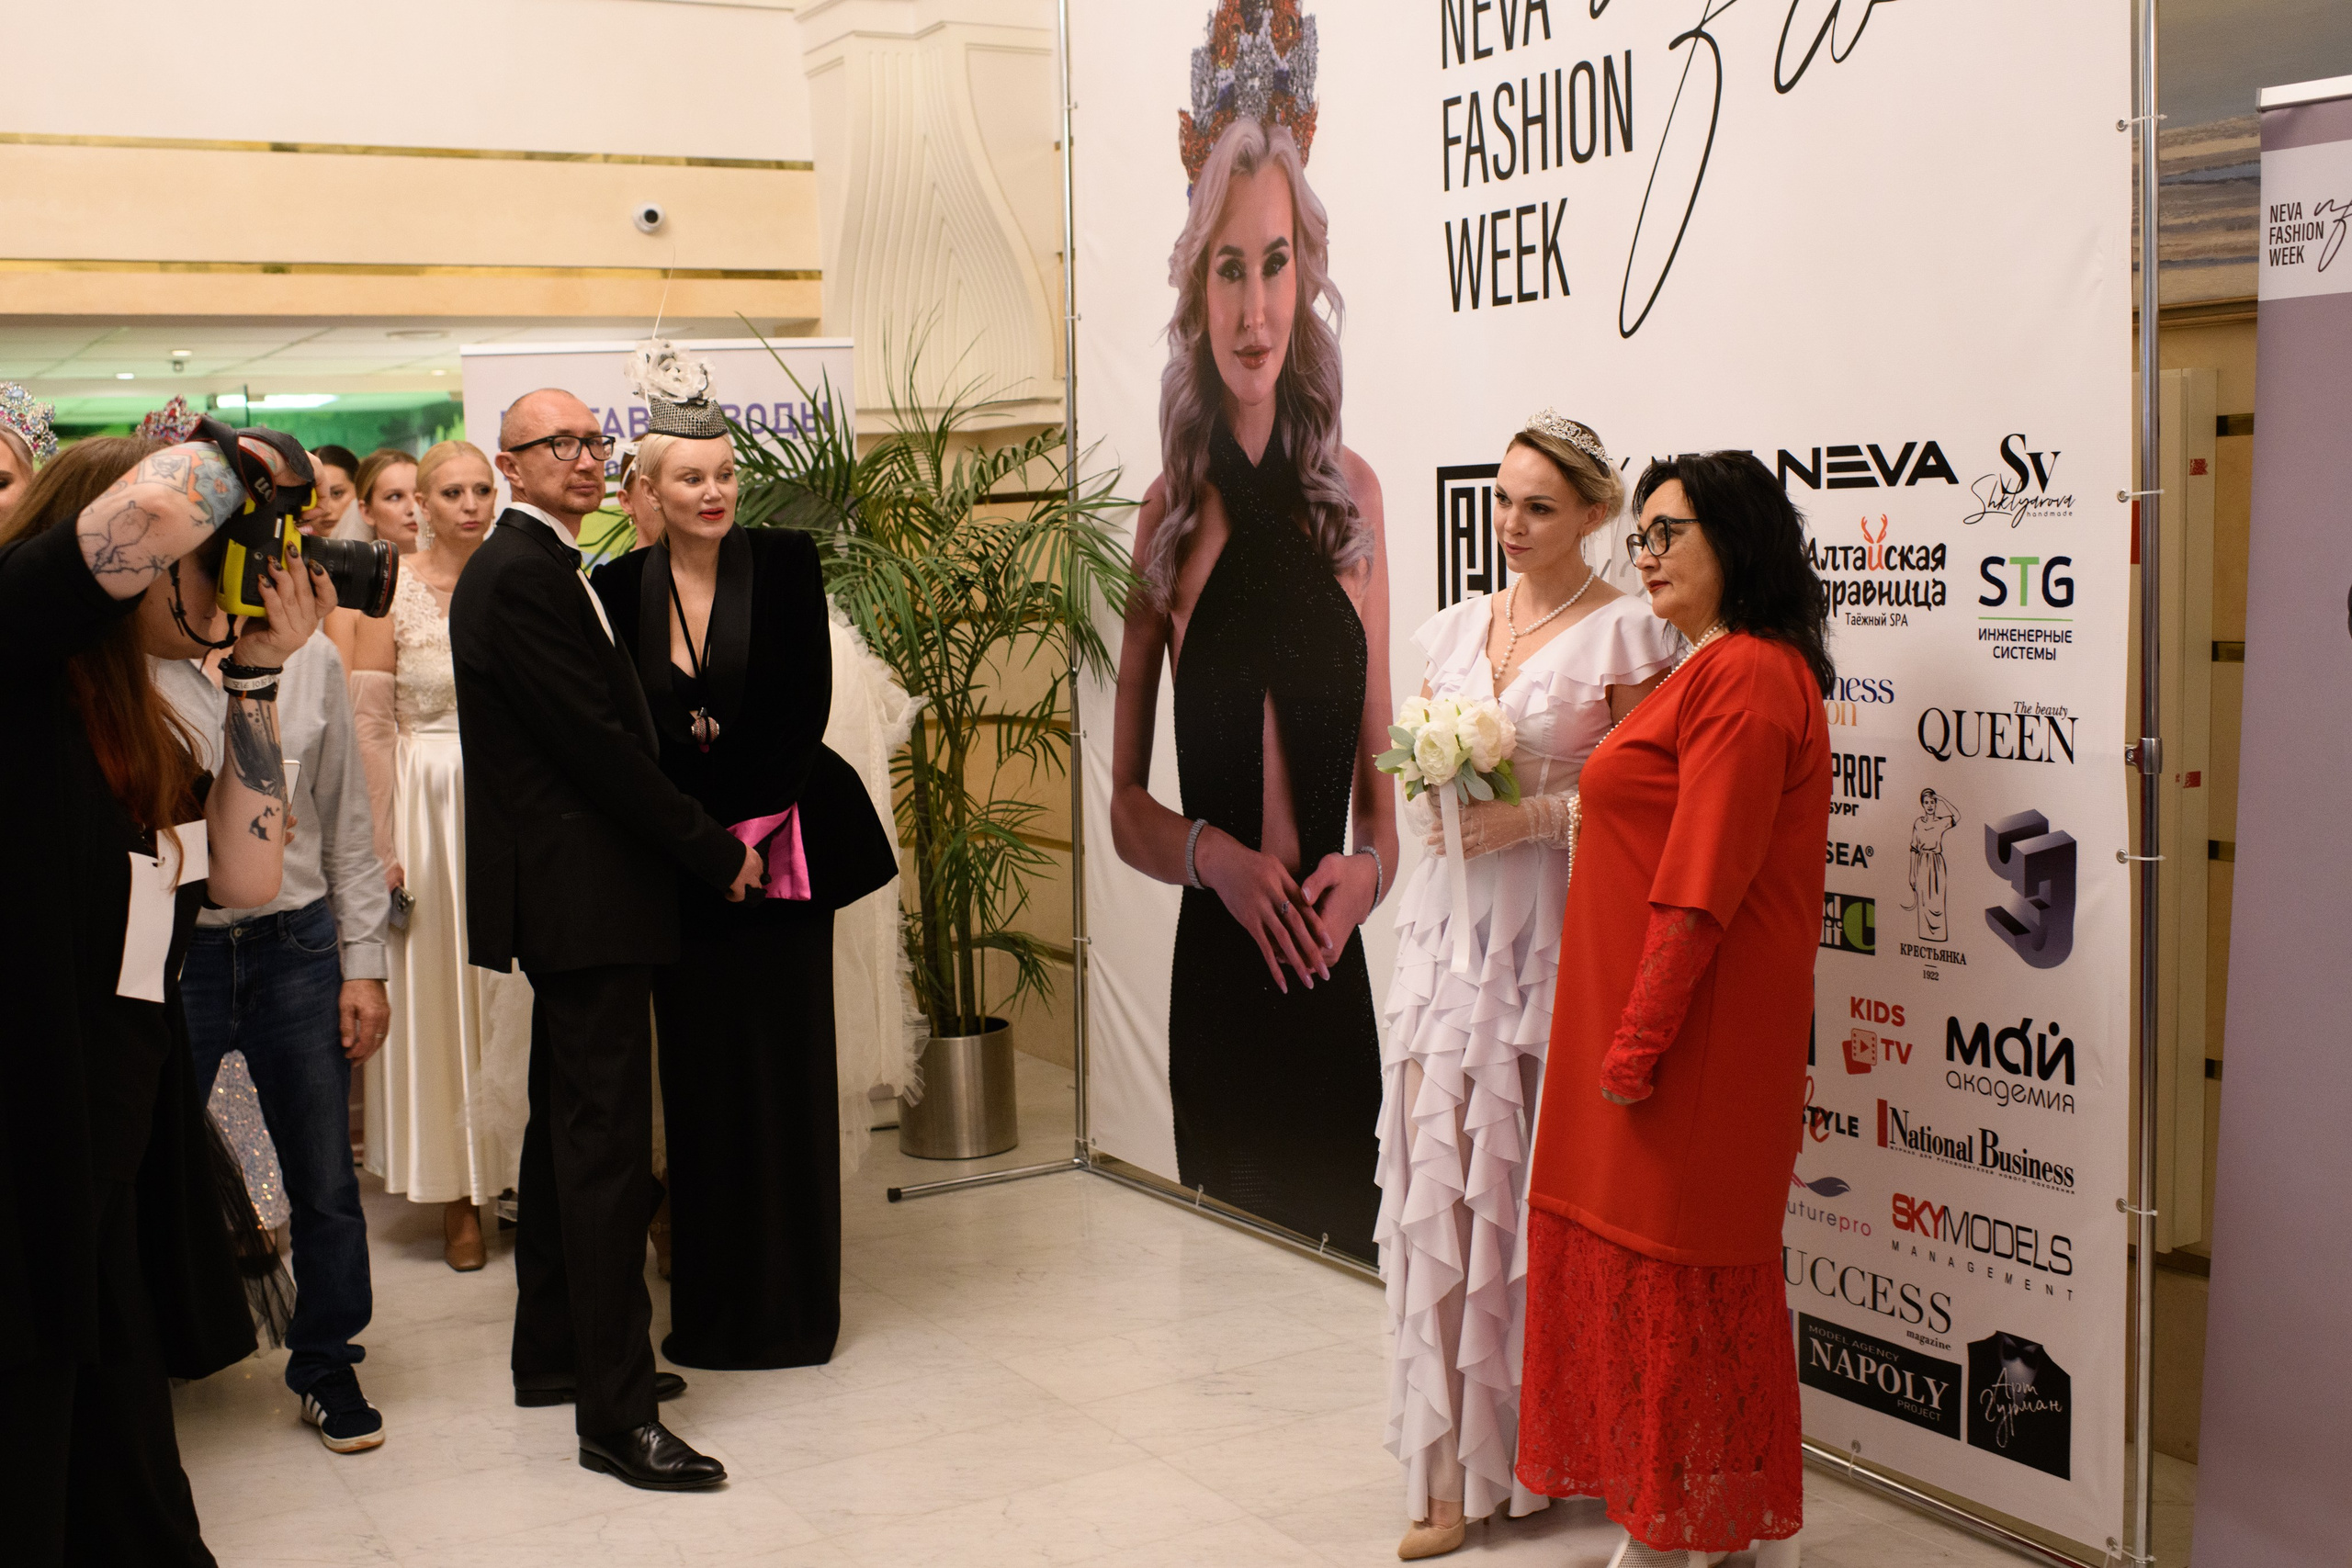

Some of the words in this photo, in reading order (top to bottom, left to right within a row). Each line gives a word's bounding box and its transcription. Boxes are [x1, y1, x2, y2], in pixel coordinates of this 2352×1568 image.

[1442, 49, 1633, 191] FASHION
[2270, 202, 2302, 223] NEVA
[2269, 220, 2324, 245] FASHION
[1445, 197, 1570, 312] WEEK
[2269, 245, 2304, 266] WEEK
[1778, 441, 1960, 490] NEVA
[1978, 556, 2074, 608] STG
[1820, 578, 1946, 617] дравница
[1845, 613, 1887, 626] Таёжный
[1890, 614, 1908, 626] SPA
[1978, 628, 2073, 643] ИНЖЕНЕРНЫЕ
[1993, 646, 2056, 660] СИСТЕМЫ
[1828, 676, 1894, 704] ness
[1826, 701, 1857, 727] on
[2014, 701, 2032, 714] The
[2035, 703, 2068, 720] beauty
[1917, 707, 2079, 764] QUEEN
[1829, 802, 1860, 817] БУРГ
[1900, 942, 1967, 965] КРЕСТЬЯНКА
[1923, 970, 1939, 981] 1922
[1850, 996, 1905, 1027] KIDS
[1881, 1038, 1913, 1065] TV
[1889, 1106, 1973, 1164] National
[1978, 1127, 2075, 1188] Business
[1787, 1201, 1871, 1236] uturepro
[1892, 1239, 2073, 1301] MANAGEMENT
[1782, 1246, 1951, 1334] UCCESS
[1808, 1325, 1849, 1345] MODEL
[1851, 1339, 1899, 1362] AGENCY
[1906, 1330, 1951, 1351] magazine
[1809, 1337, 1950, 1411] NAPOLY
[1897, 1399, 1941, 1422] PROJECT
